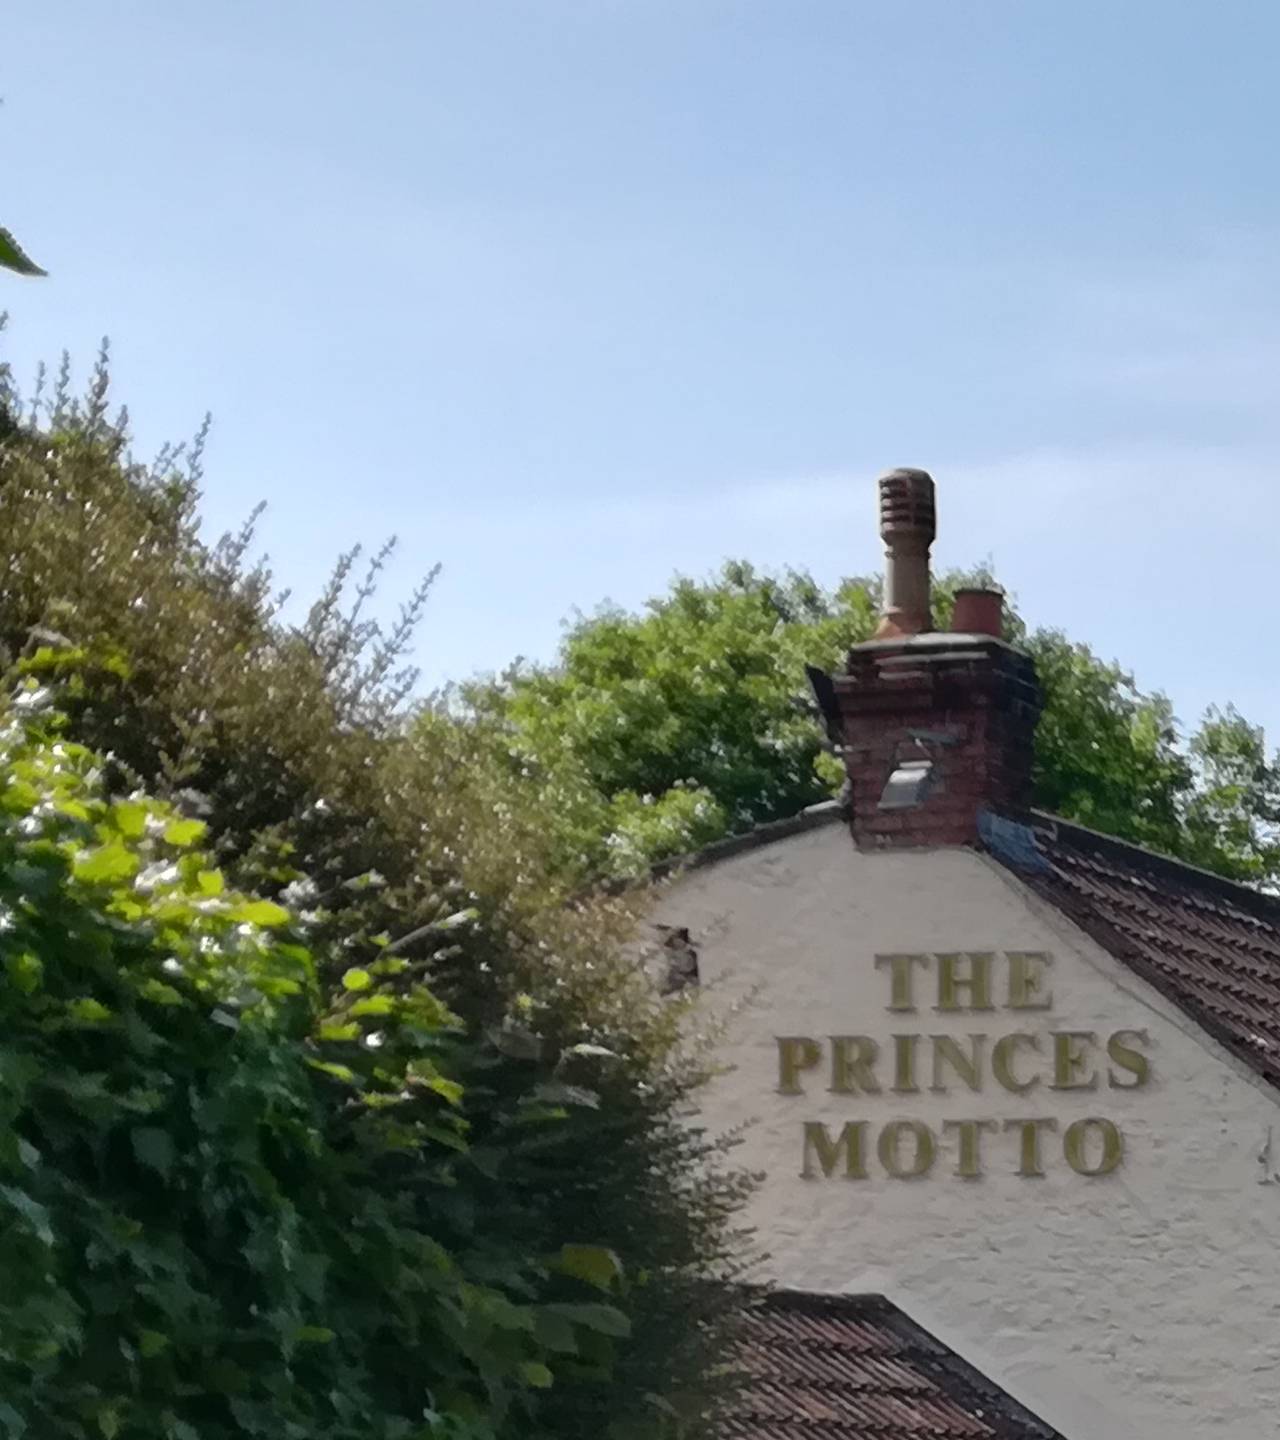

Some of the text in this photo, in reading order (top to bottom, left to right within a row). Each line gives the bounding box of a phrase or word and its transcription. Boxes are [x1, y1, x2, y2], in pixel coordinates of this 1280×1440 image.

[874, 951, 1053, 1012] THE
[774, 1029, 1152, 1095] PRINCES
[800, 1117, 1124, 1180] MOTTO
